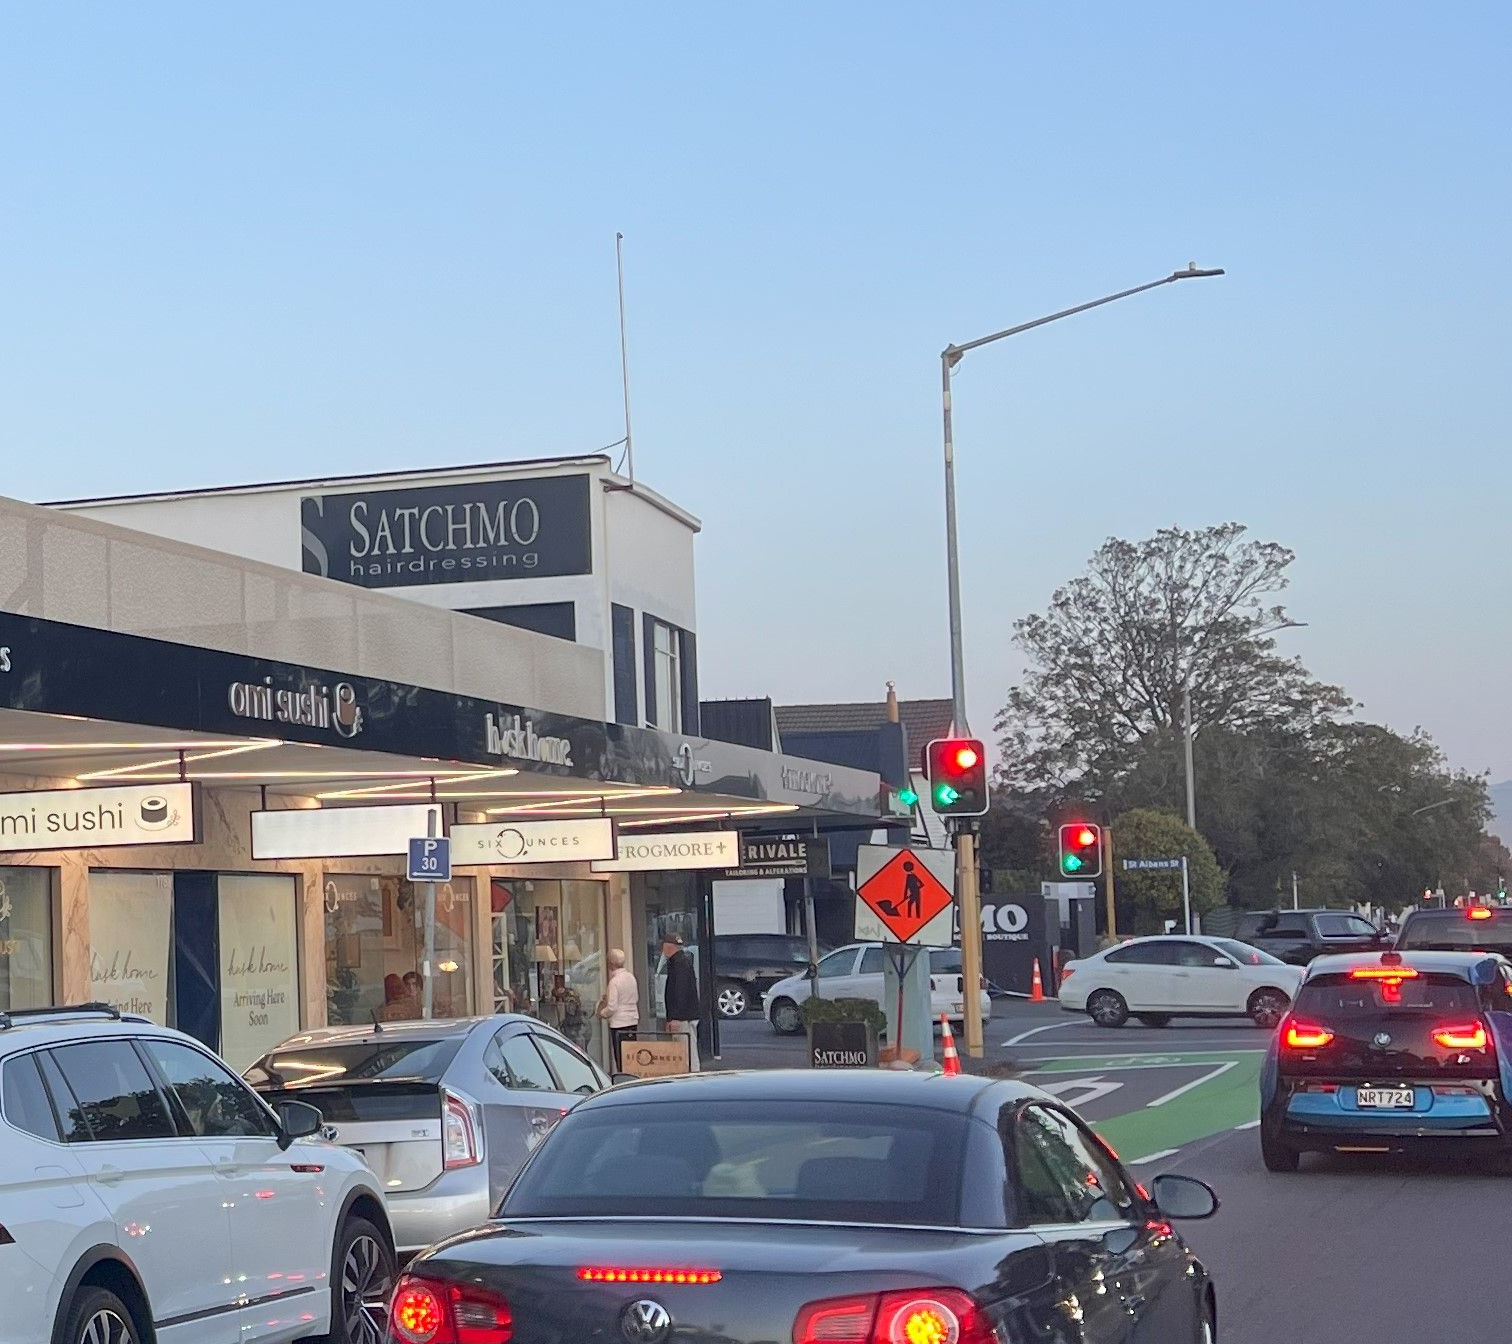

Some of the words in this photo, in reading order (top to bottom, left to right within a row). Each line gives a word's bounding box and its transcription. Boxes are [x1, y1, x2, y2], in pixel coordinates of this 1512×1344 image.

[349, 497, 539, 558] SATCHMO
[350, 551, 538, 576] hairdressing
[229, 676, 274, 720] omi
[276, 685, 329, 728] sushi
[47, 802, 123, 832] sushi
[424, 840, 438, 857] P
[478, 840, 502, 849] SIX
[421, 857, 437, 870] 30
[130, 997, 153, 1014] Here
[234, 991, 266, 1010] Arriving
[267, 988, 285, 1005] Here
[248, 1010, 268, 1027] Soon
[814, 1048, 867, 1064] SATCHMO
[1358, 1090, 1412, 1104] NRT724
